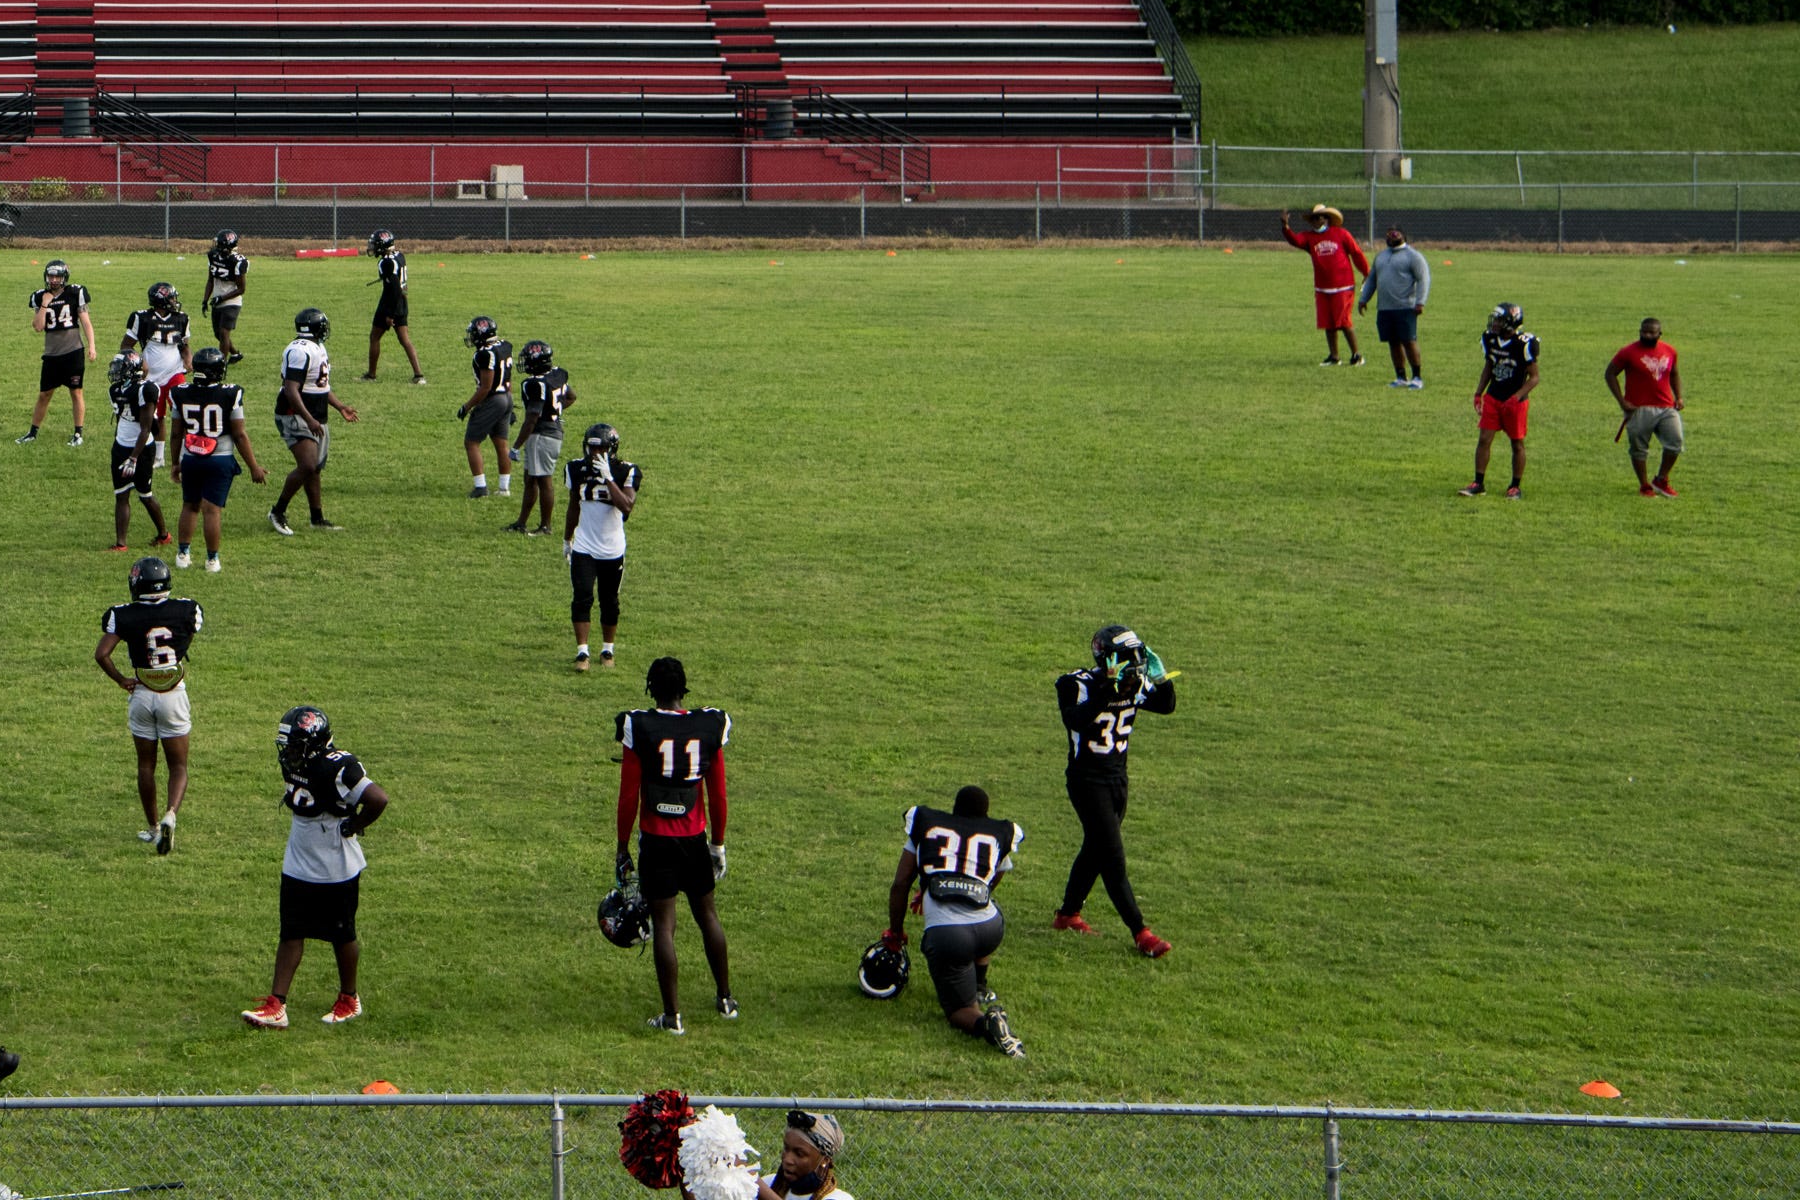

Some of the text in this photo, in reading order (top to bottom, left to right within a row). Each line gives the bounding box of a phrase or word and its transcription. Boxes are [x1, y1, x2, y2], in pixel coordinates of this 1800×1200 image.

[181, 403, 224, 438] 50
[145, 626, 178, 669] 6
[1088, 708, 1136, 755] 35
[658, 739, 703, 781] 11
[659, 805, 684, 813] BATTLE
[923, 826, 1000, 885] 30
[939, 880, 983, 894] XENITH
